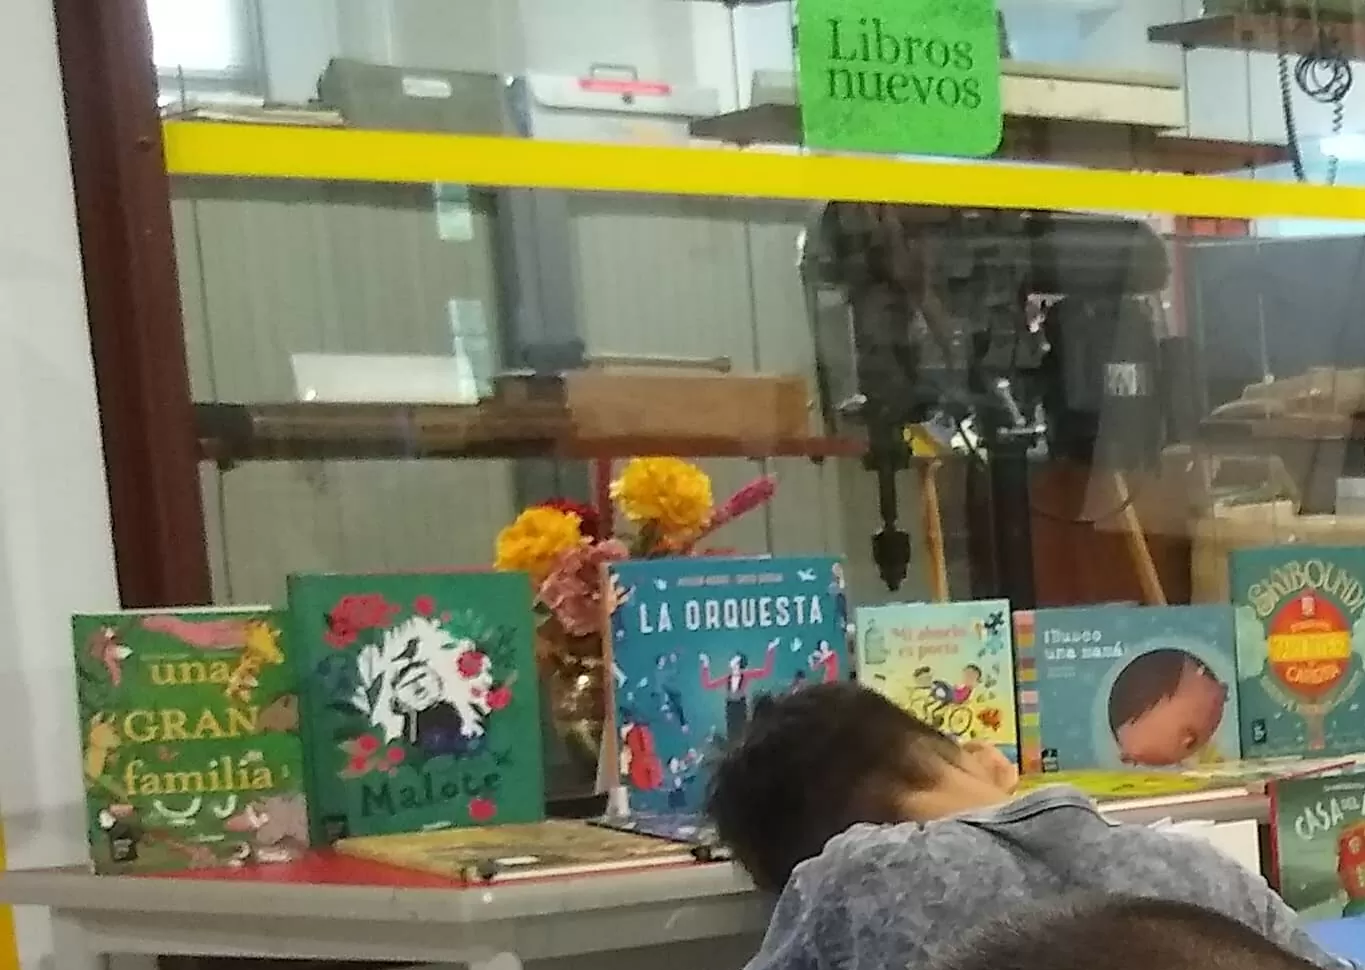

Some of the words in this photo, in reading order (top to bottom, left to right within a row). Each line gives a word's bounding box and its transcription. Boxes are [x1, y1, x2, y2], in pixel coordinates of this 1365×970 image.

[827, 17, 974, 71] Libros
[828, 69, 982, 109] nuevos
[638, 602, 673, 634] LA
[685, 595, 824, 631] ORQUESTA
[151, 659, 230, 686] una
[123, 706, 259, 743] GRAN
[125, 755, 273, 797] familia
[361, 771, 502, 817] Malote
[1295, 797, 1344, 840] CASA
